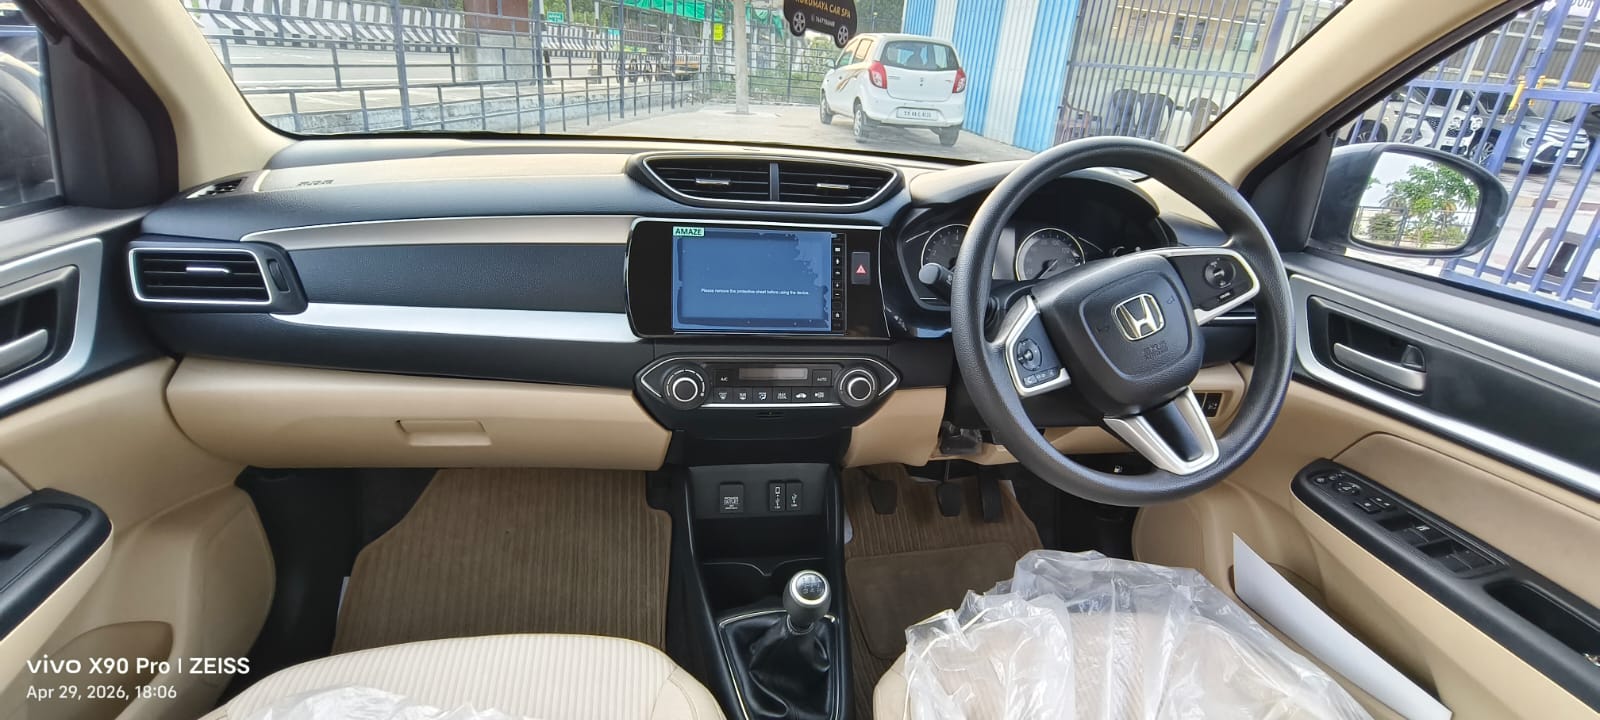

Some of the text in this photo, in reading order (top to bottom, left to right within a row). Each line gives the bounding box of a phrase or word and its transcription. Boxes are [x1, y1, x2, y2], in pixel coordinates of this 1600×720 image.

[829, 4, 841, 15] CAR
[841, 7, 851, 19] SPA
[675, 228, 702, 236] AMAZE
